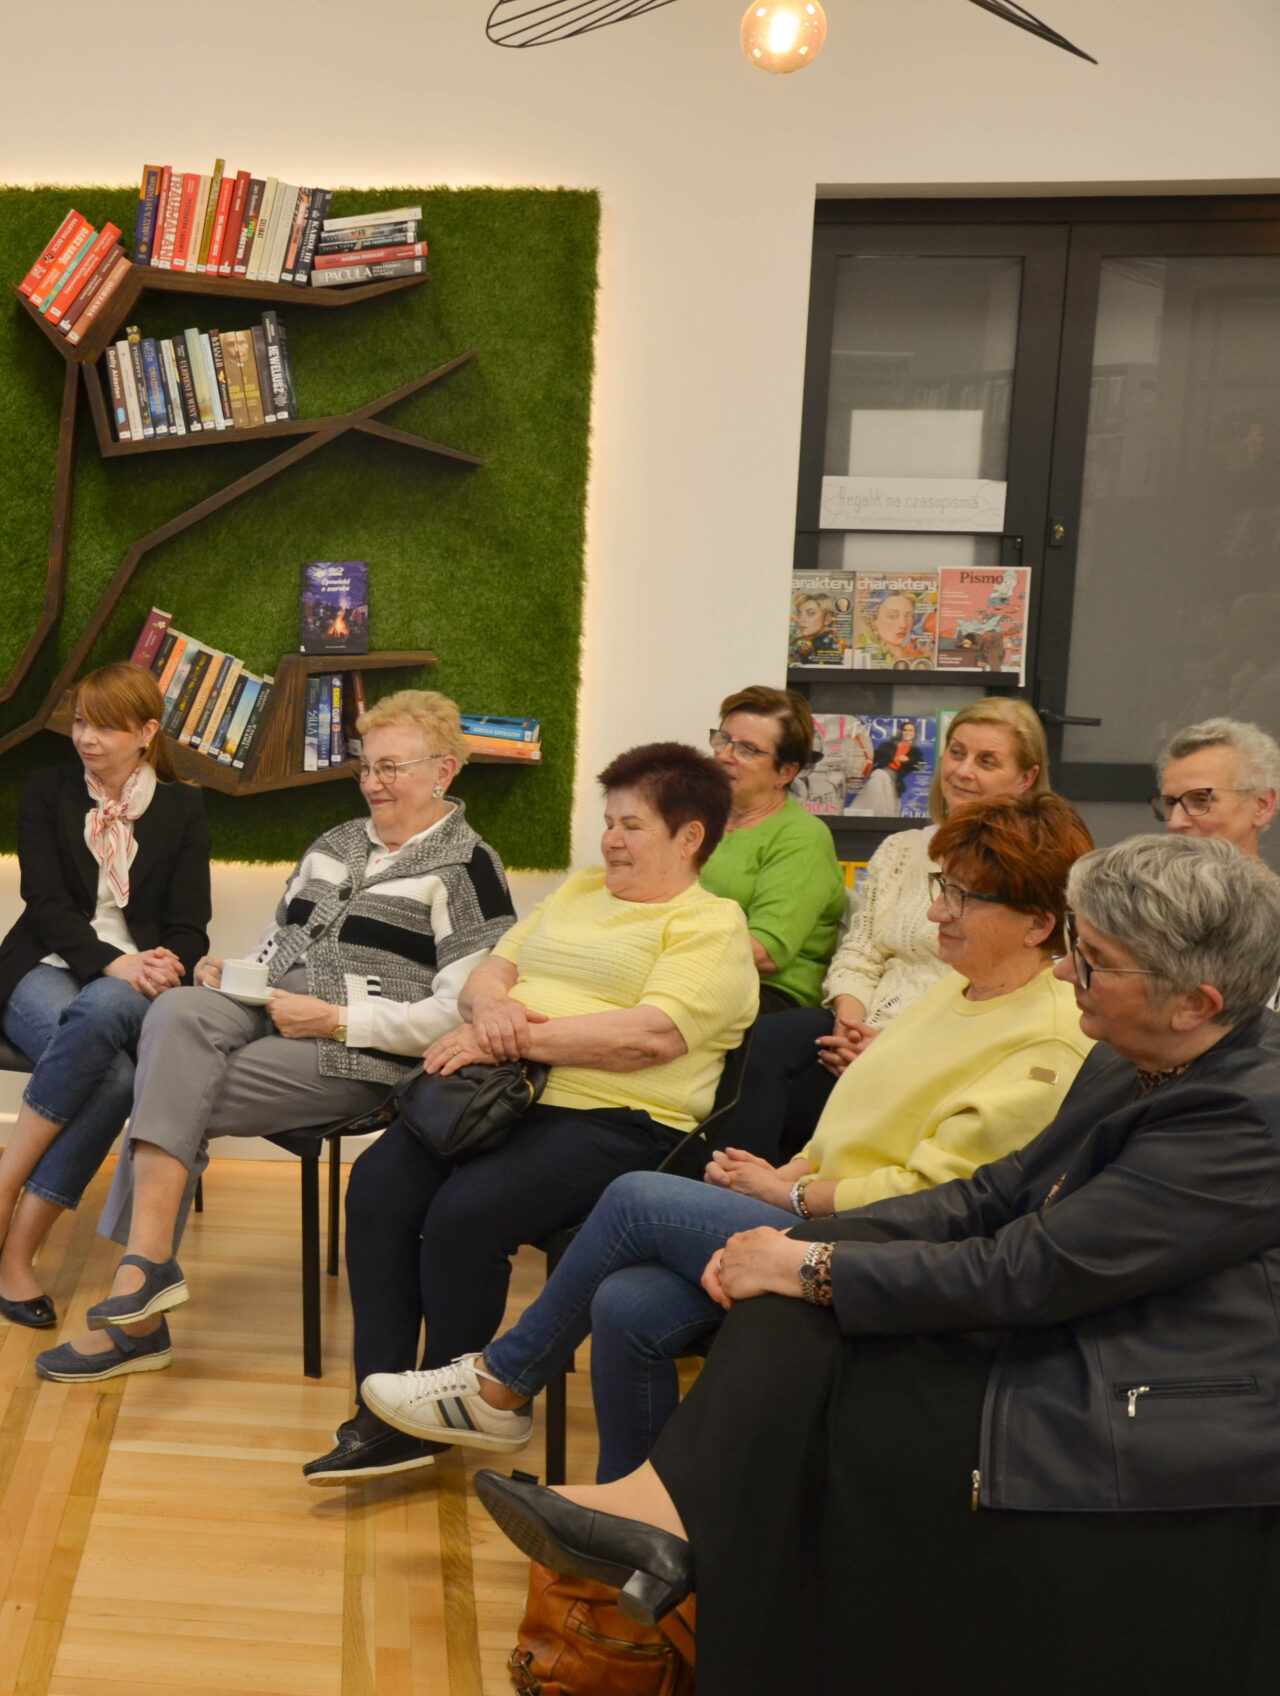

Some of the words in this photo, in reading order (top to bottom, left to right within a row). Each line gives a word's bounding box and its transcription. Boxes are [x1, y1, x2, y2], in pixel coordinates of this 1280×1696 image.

[159, 173, 183, 261] TRAUMALAN
[305, 219, 318, 251] KAROL
[303, 252, 311, 262] III
[107, 349, 117, 368] Dolly
[267, 345, 284, 394] HEWELIUSZ
[110, 368, 122, 398] Alderton
[886, 496, 901, 508] na
[857, 576, 937, 593] charaktery
[960, 571, 1004, 584] Pismo
